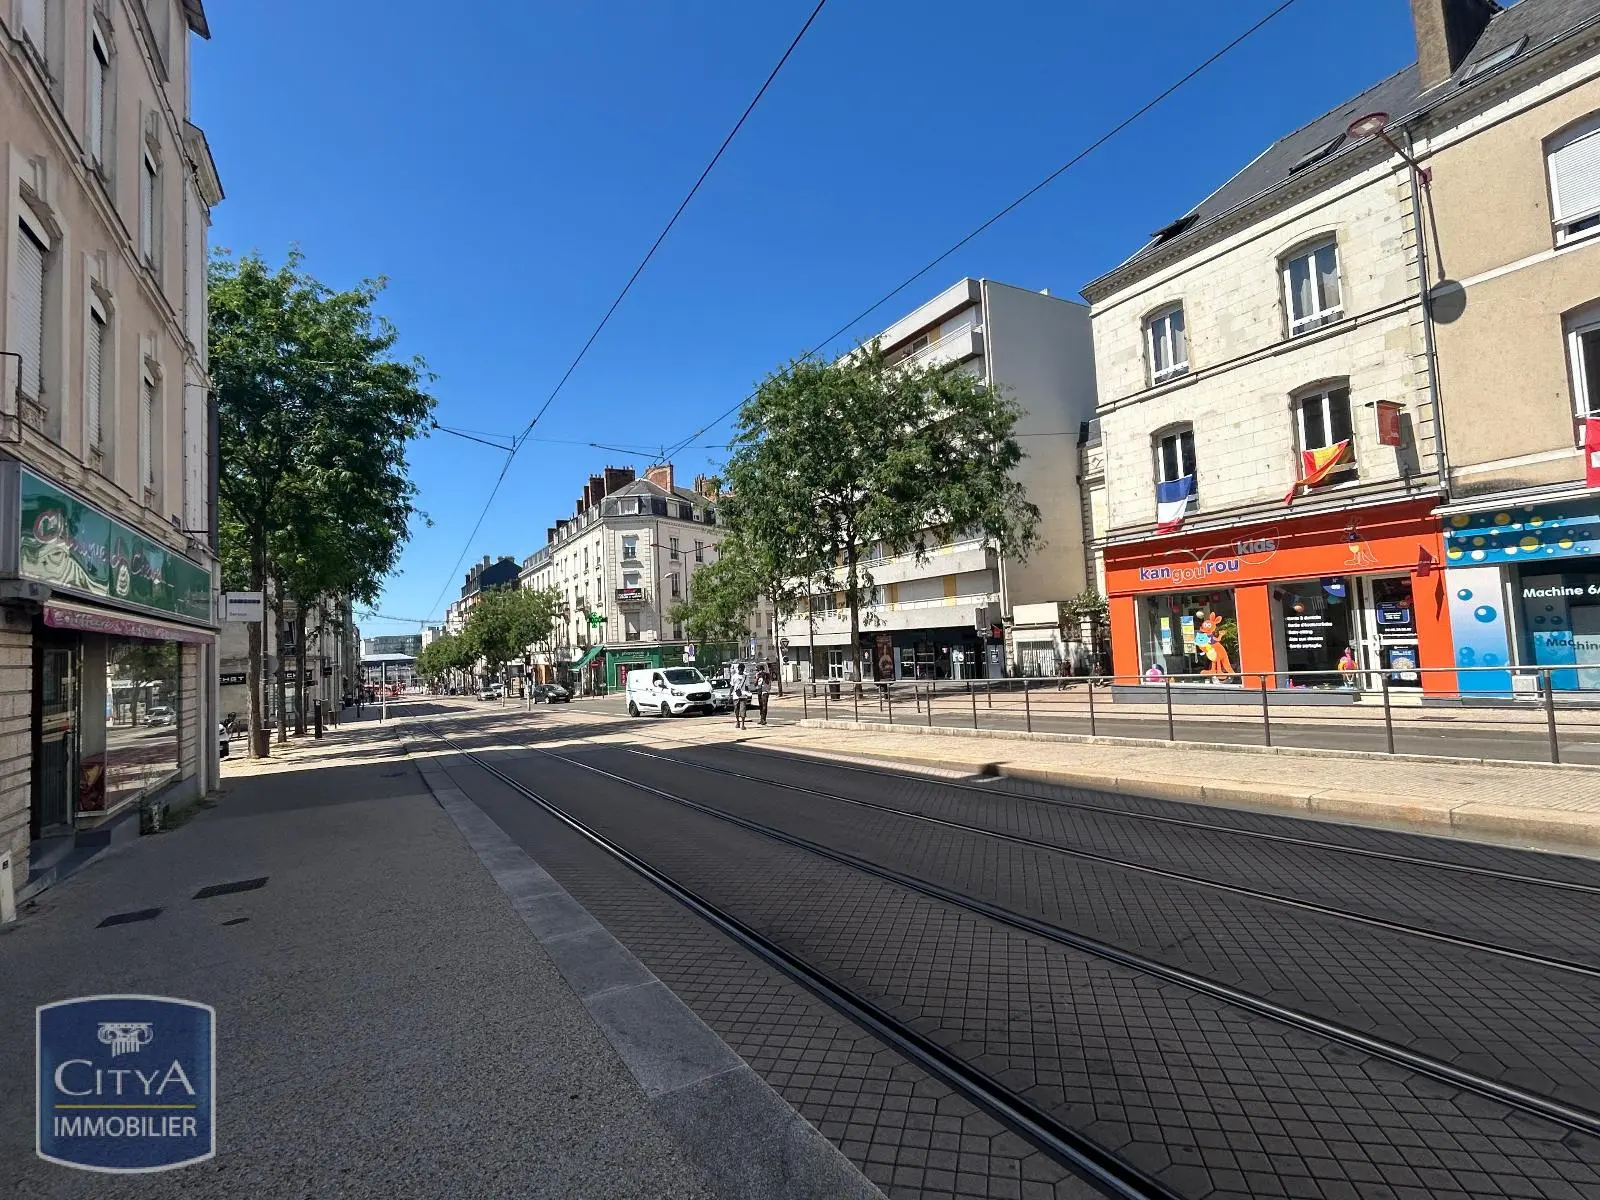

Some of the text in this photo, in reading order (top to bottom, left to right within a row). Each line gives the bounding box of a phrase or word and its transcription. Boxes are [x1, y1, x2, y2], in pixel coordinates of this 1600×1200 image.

[1139, 539, 1276, 584] kangourou kids
[1523, 586, 1584, 598] Machine
